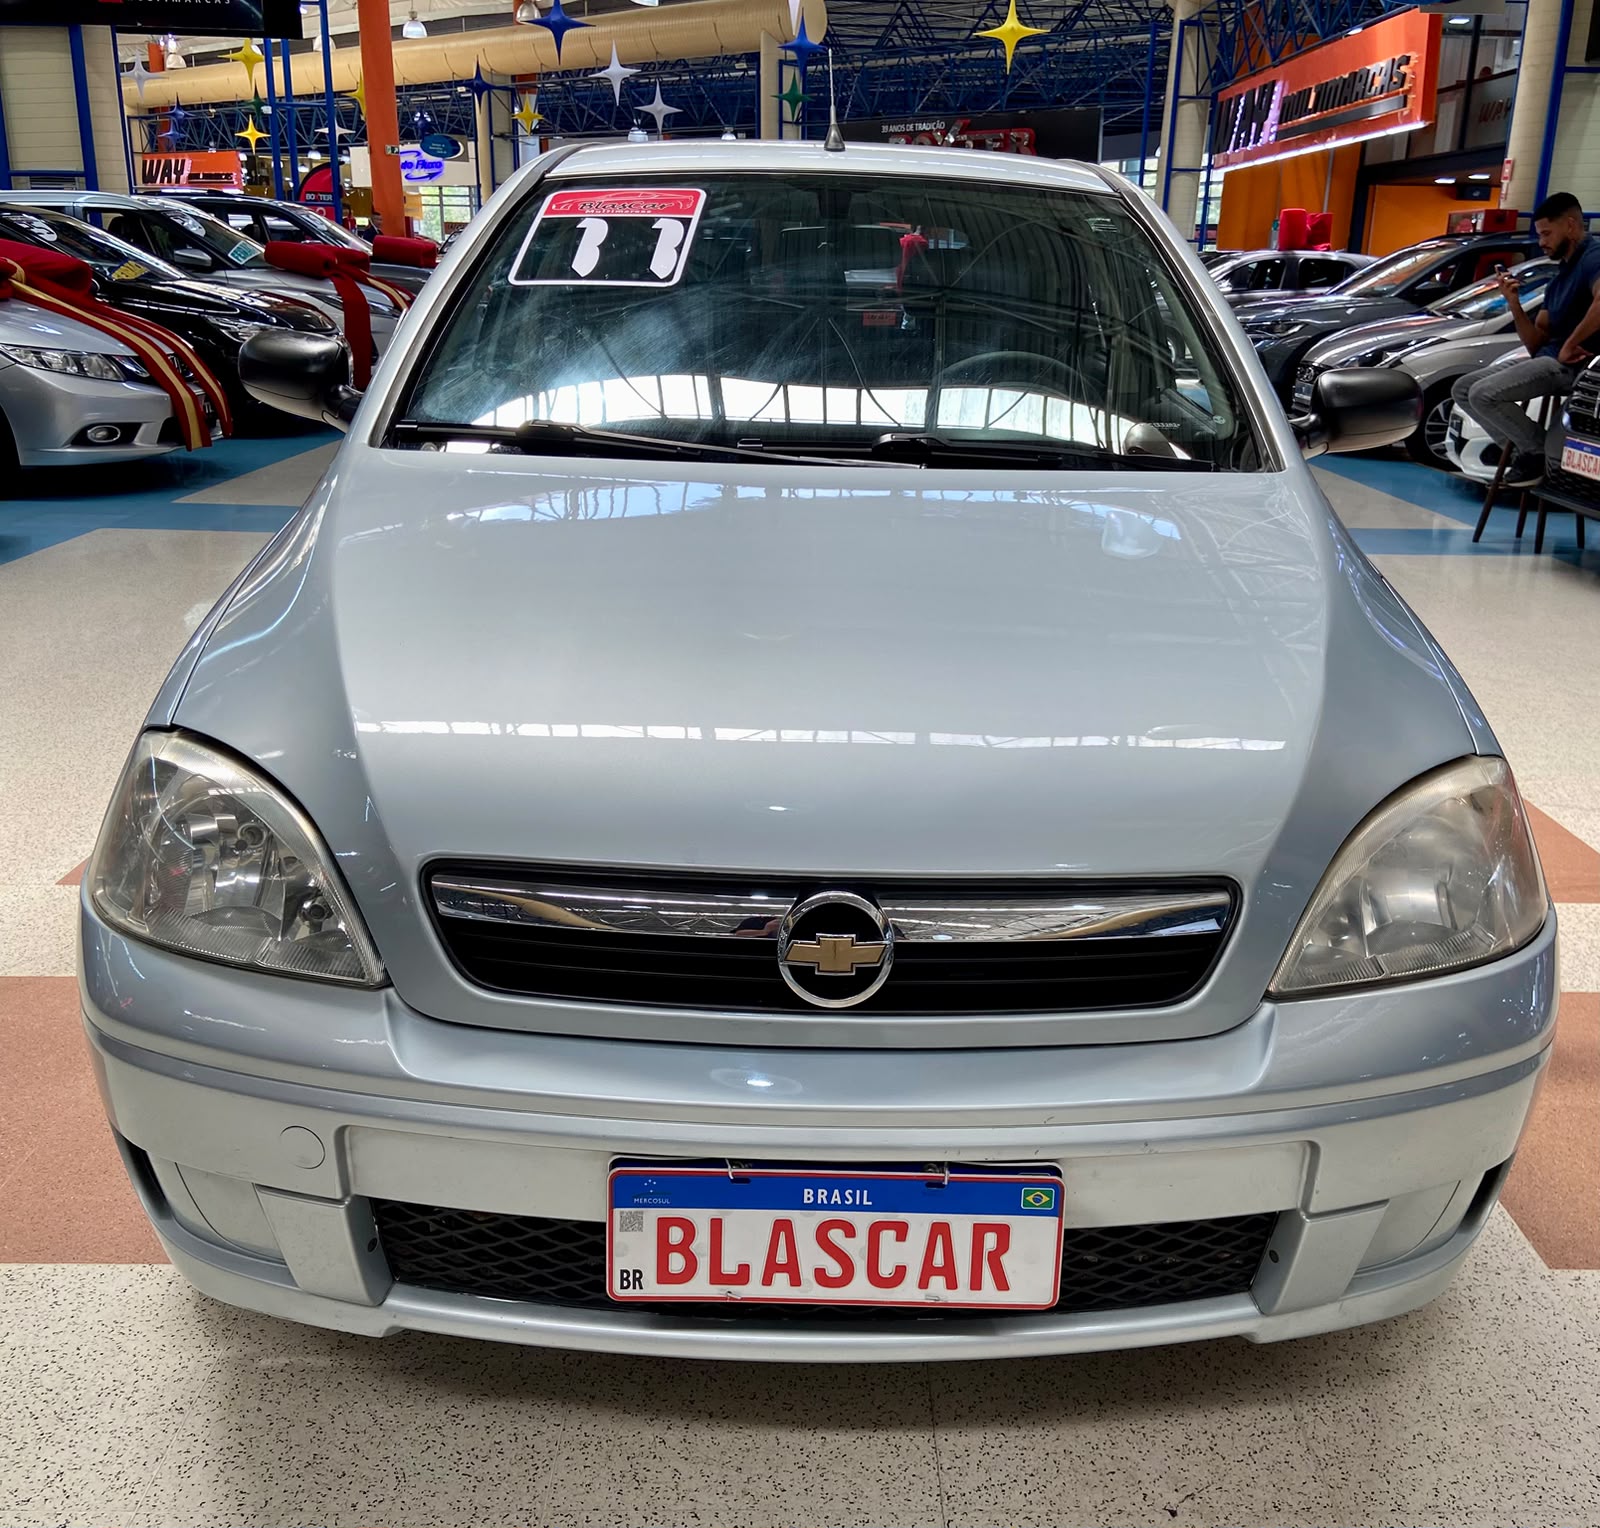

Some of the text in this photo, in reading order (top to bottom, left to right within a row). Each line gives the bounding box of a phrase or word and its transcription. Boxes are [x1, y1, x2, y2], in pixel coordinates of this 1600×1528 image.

[889, 123, 905, 133] ANOS
[906, 123, 915, 132] DE
[142, 159, 187, 185] WAY
[803, 1188, 873, 1206] BRASIL
[655, 1215, 1011, 1291] BLASCAR
[619, 1269, 644, 1290] BR
